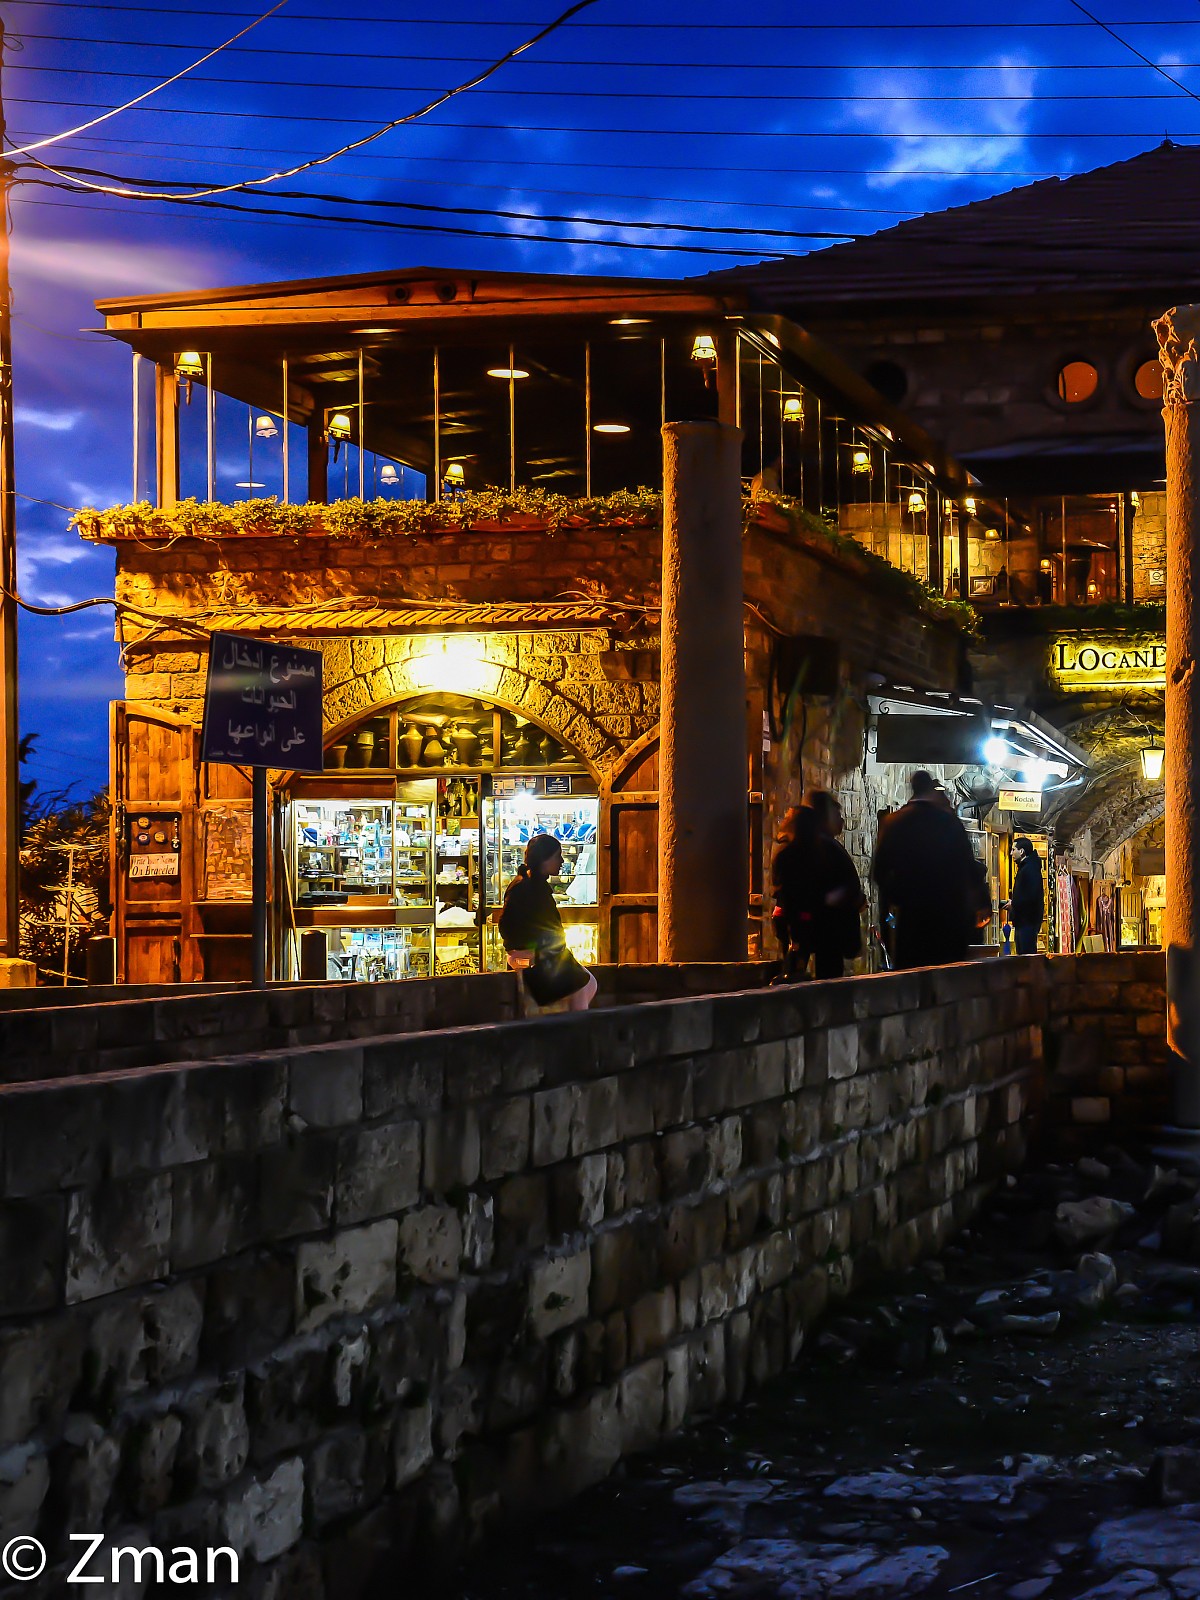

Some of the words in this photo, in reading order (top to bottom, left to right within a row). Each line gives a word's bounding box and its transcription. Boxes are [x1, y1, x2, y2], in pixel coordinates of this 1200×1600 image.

[270, 654, 316, 684] ممنوع
[1056, 643, 1166, 671] LOCAND
[241, 685, 297, 713] الحيوانات
[280, 726, 306, 752] على
